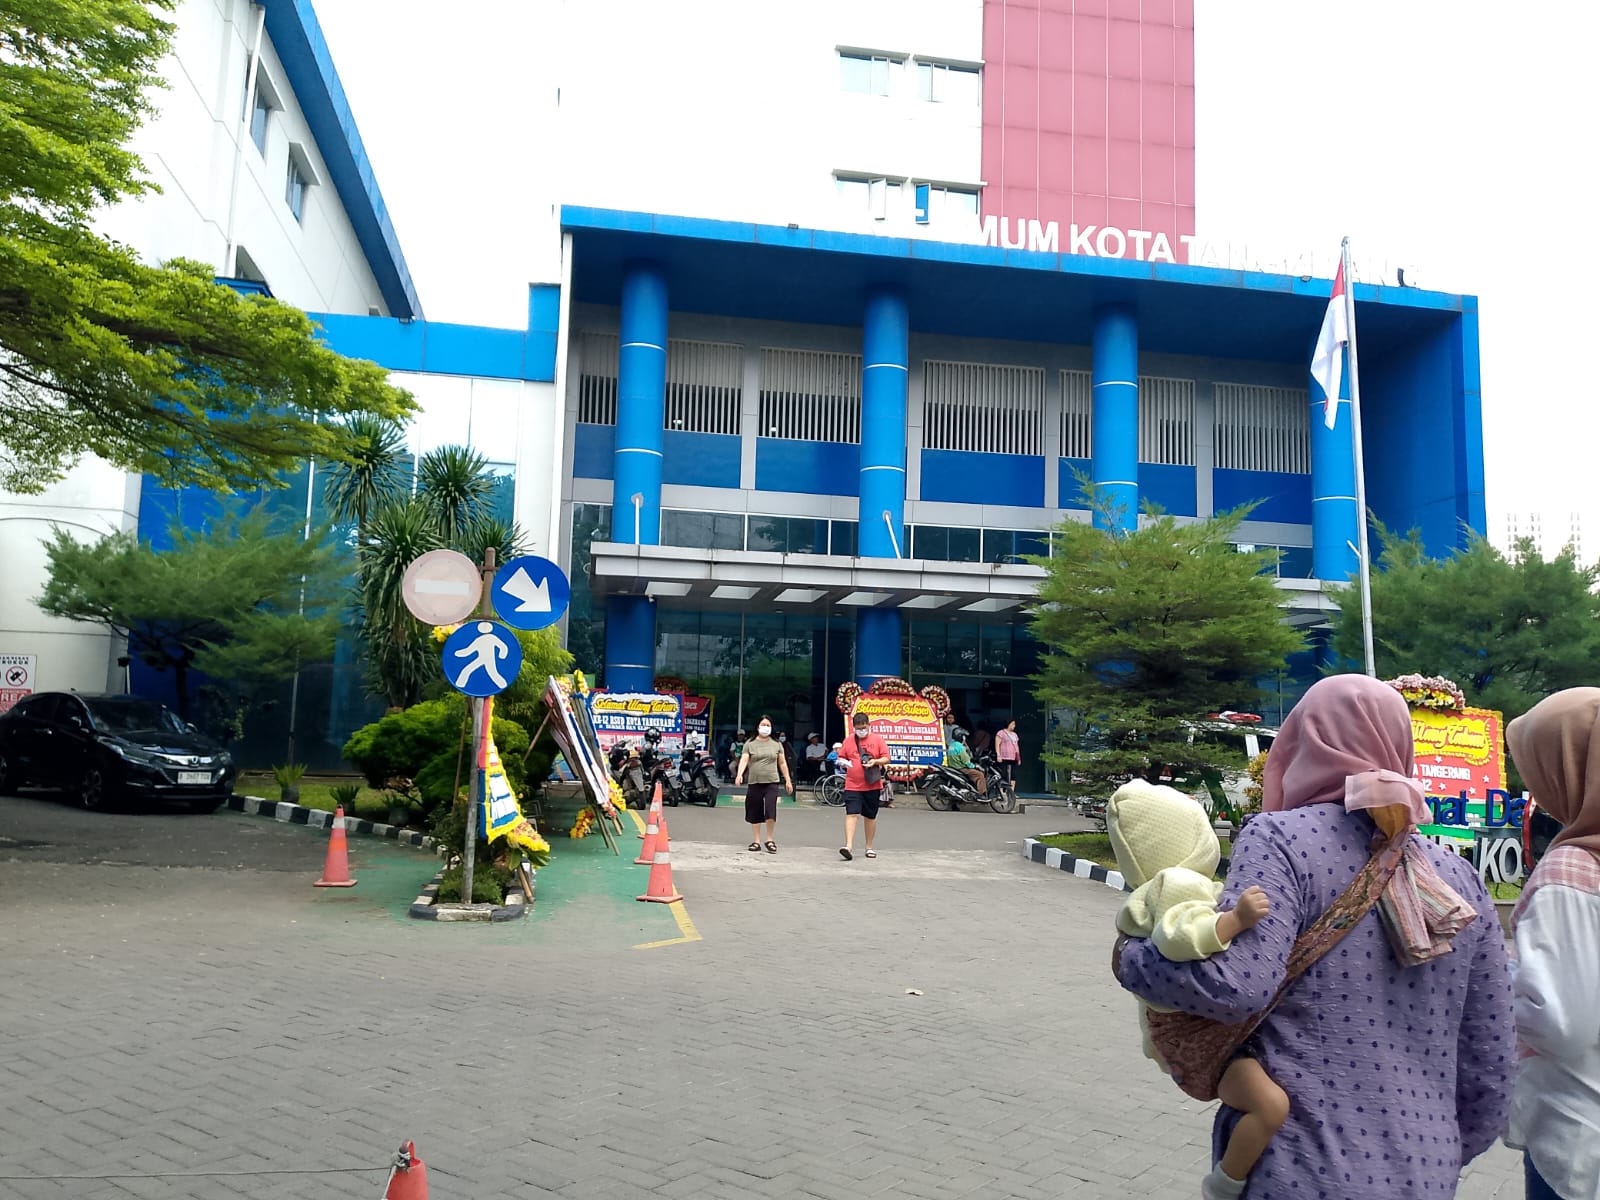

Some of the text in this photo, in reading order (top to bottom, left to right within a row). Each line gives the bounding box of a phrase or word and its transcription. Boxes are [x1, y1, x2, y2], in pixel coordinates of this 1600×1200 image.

[970, 214, 1059, 253] MUM
[1070, 223, 1177, 264] KOTA
[626, 699, 651, 714] Ulang
[626, 717, 642, 727] KOTA
[642, 718, 676, 728] TANGERANG
[894, 725, 908, 734] KOTA
[908, 726, 938, 736] TANGERANG
[1420, 763, 1471, 781] TANGERANG
